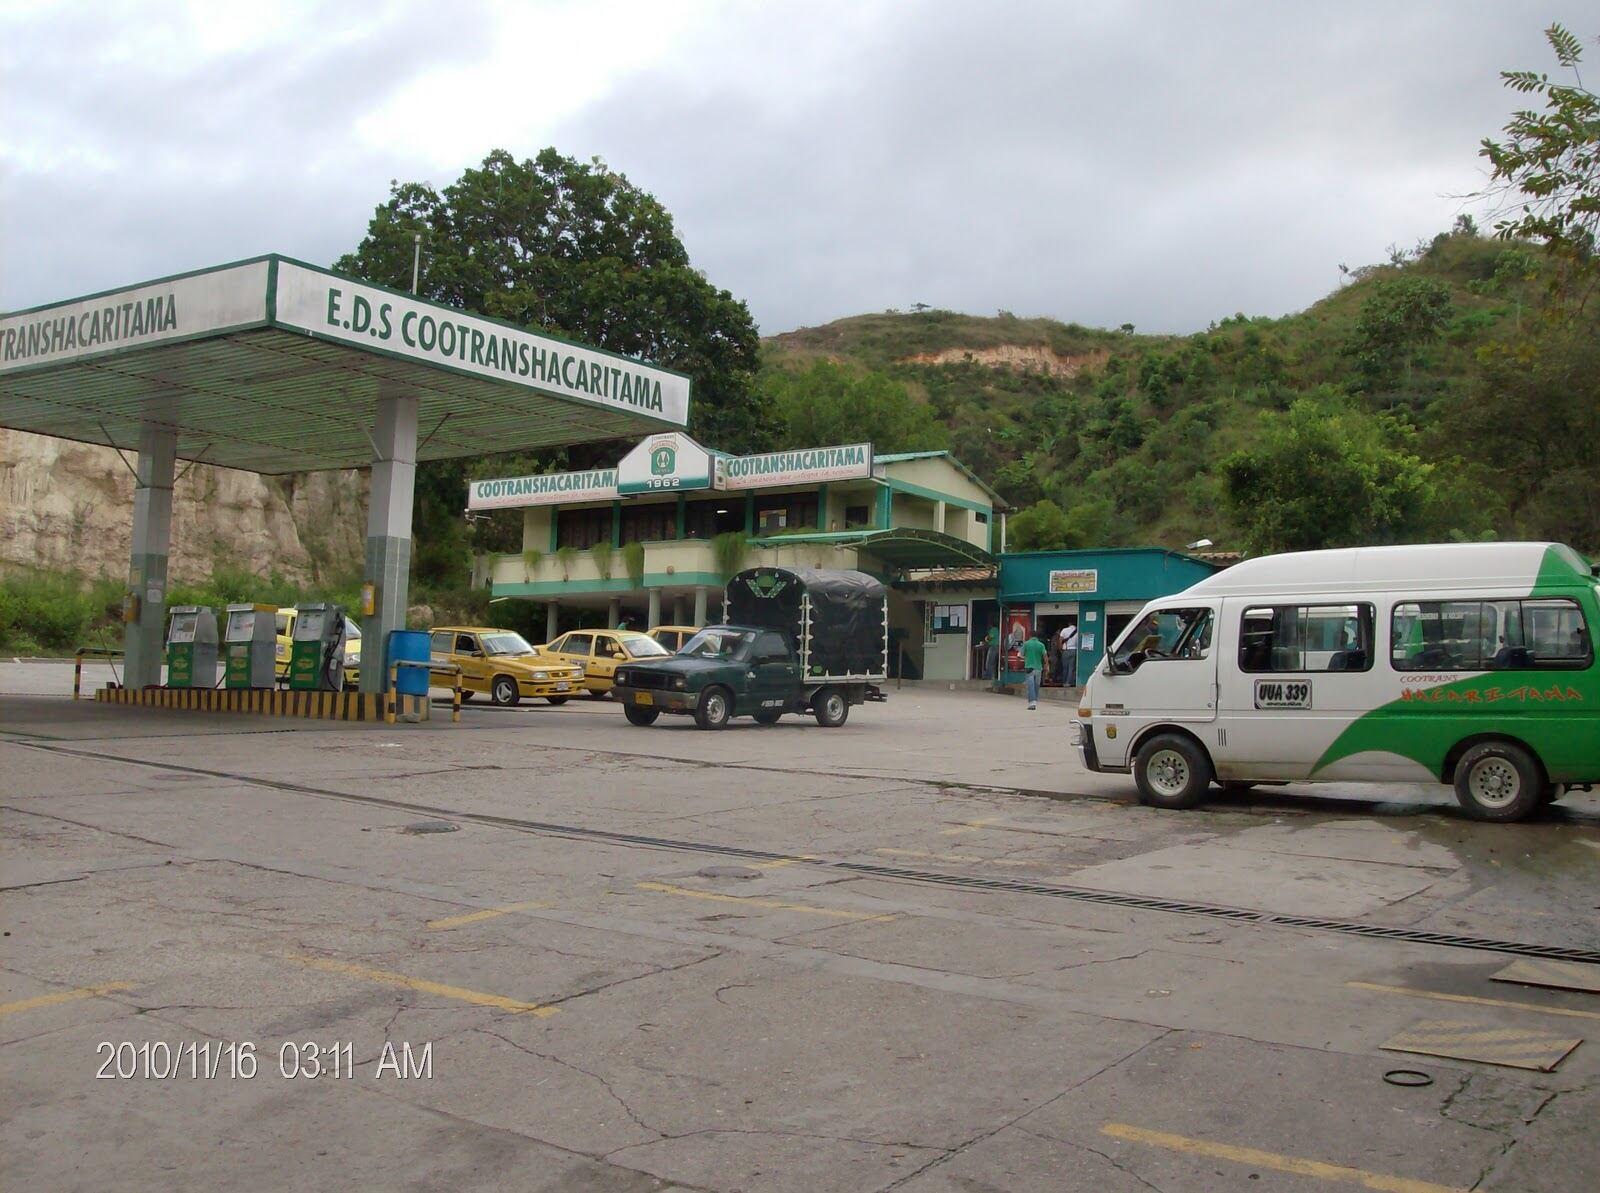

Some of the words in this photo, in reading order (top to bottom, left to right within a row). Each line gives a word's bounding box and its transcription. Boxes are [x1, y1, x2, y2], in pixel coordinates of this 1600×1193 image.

[327, 288, 393, 340] E.D.S
[402, 312, 663, 413] COOTRANSHACARITAMA
[727, 447, 864, 477] COOTRANSHACARITAMA
[646, 478, 680, 488] 1962
[1400, 674, 1458, 683] COOTRANS
[1259, 684, 1282, 701] UUA
[1285, 684, 1308, 702] 339
